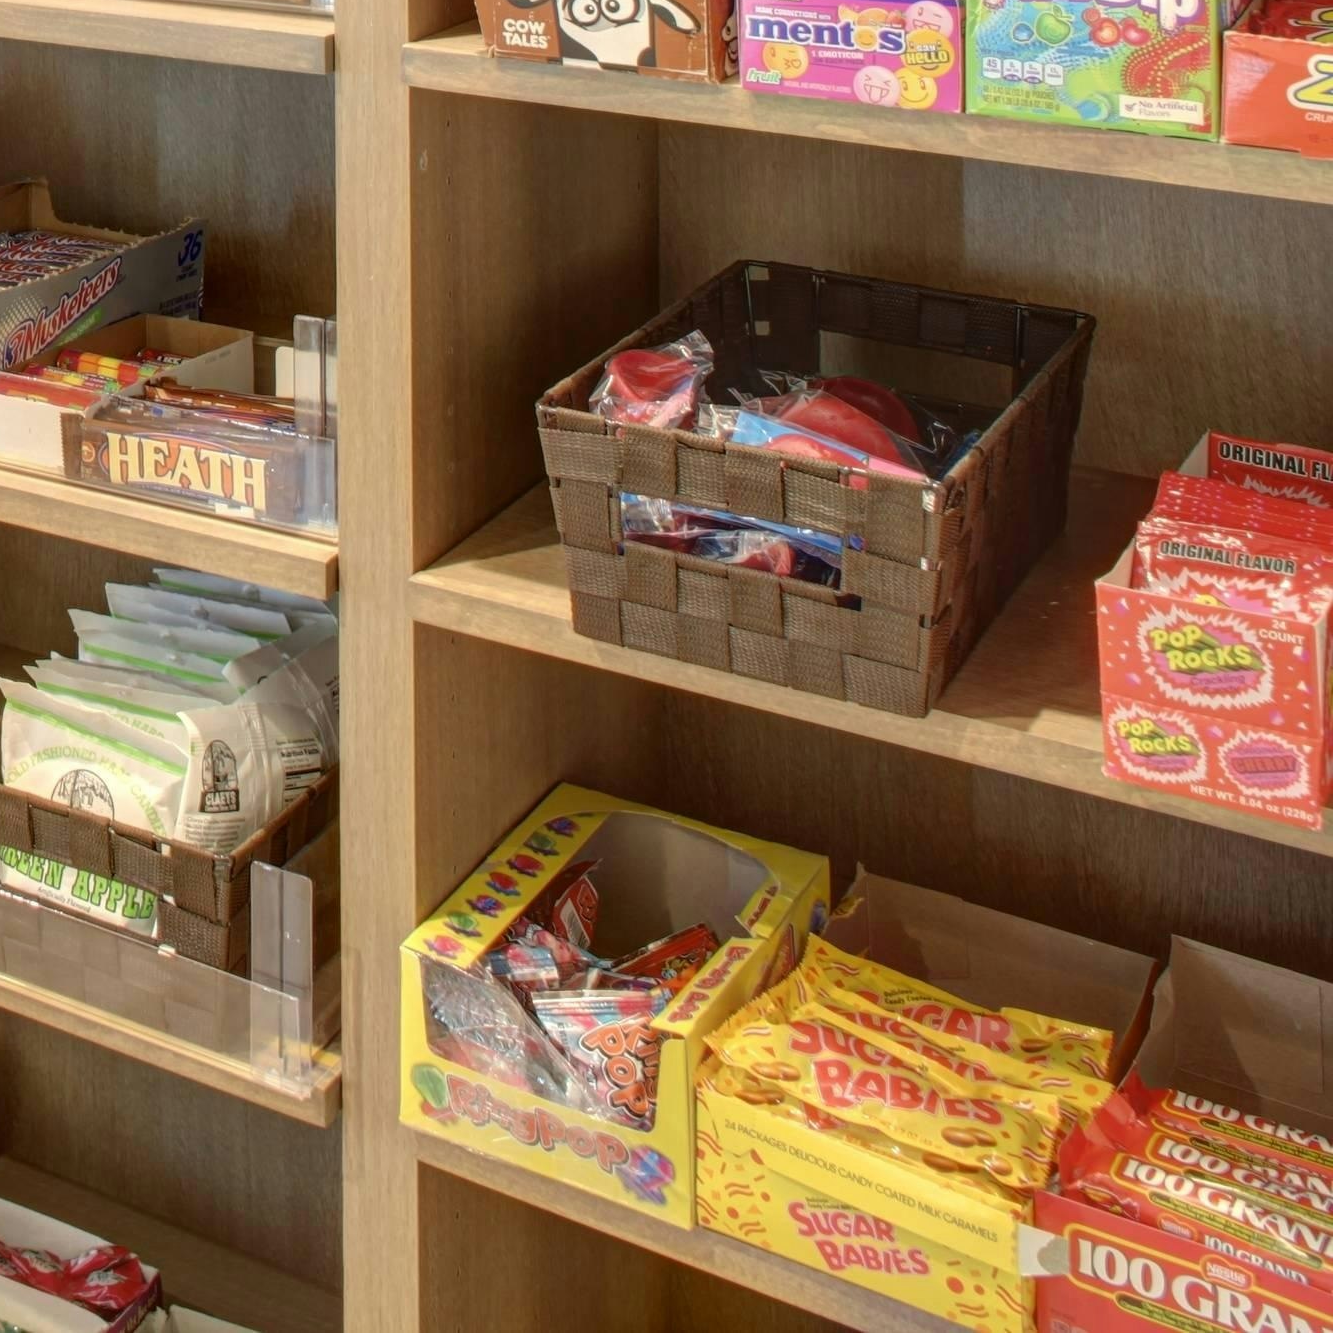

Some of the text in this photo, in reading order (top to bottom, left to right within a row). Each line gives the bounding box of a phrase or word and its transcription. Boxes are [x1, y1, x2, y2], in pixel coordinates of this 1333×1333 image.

[503, 31, 547, 48] TALES
[504, 18, 546, 35] COW
[748, 69, 781, 83] fruit
[1155, 102, 1197, 112] Artificial
[176, 229, 204, 267] 36
[25, 257, 122, 357] Musketeers
[107, 431, 268, 517] HEATH
[1219, 441, 1307, 477] ORIGINAL
[1160, 541, 1296, 574] ORIGINAL FLAVOR
[1259, 628, 1305, 646] COUNT
[1271, 619, 1287, 630] 24
[1150, 625, 1256, 671] POP ROCKS
[72, 868, 157, 919] APPLE
[813, 1058, 1004, 1127] BABIES
[724, 1119, 998, 1244] 24 PACKAGES DELICIOUS CANDY COATED MILK CARAMELS
[1121, 1160, 1196, 1199] 100
[788, 1201, 896, 1243] SUGAR
[815, 1239, 930, 1275] BABIES
[1076, 1237, 1166, 1301] 100
[1204, 1234, 1308, 1286] 100 GRAND
